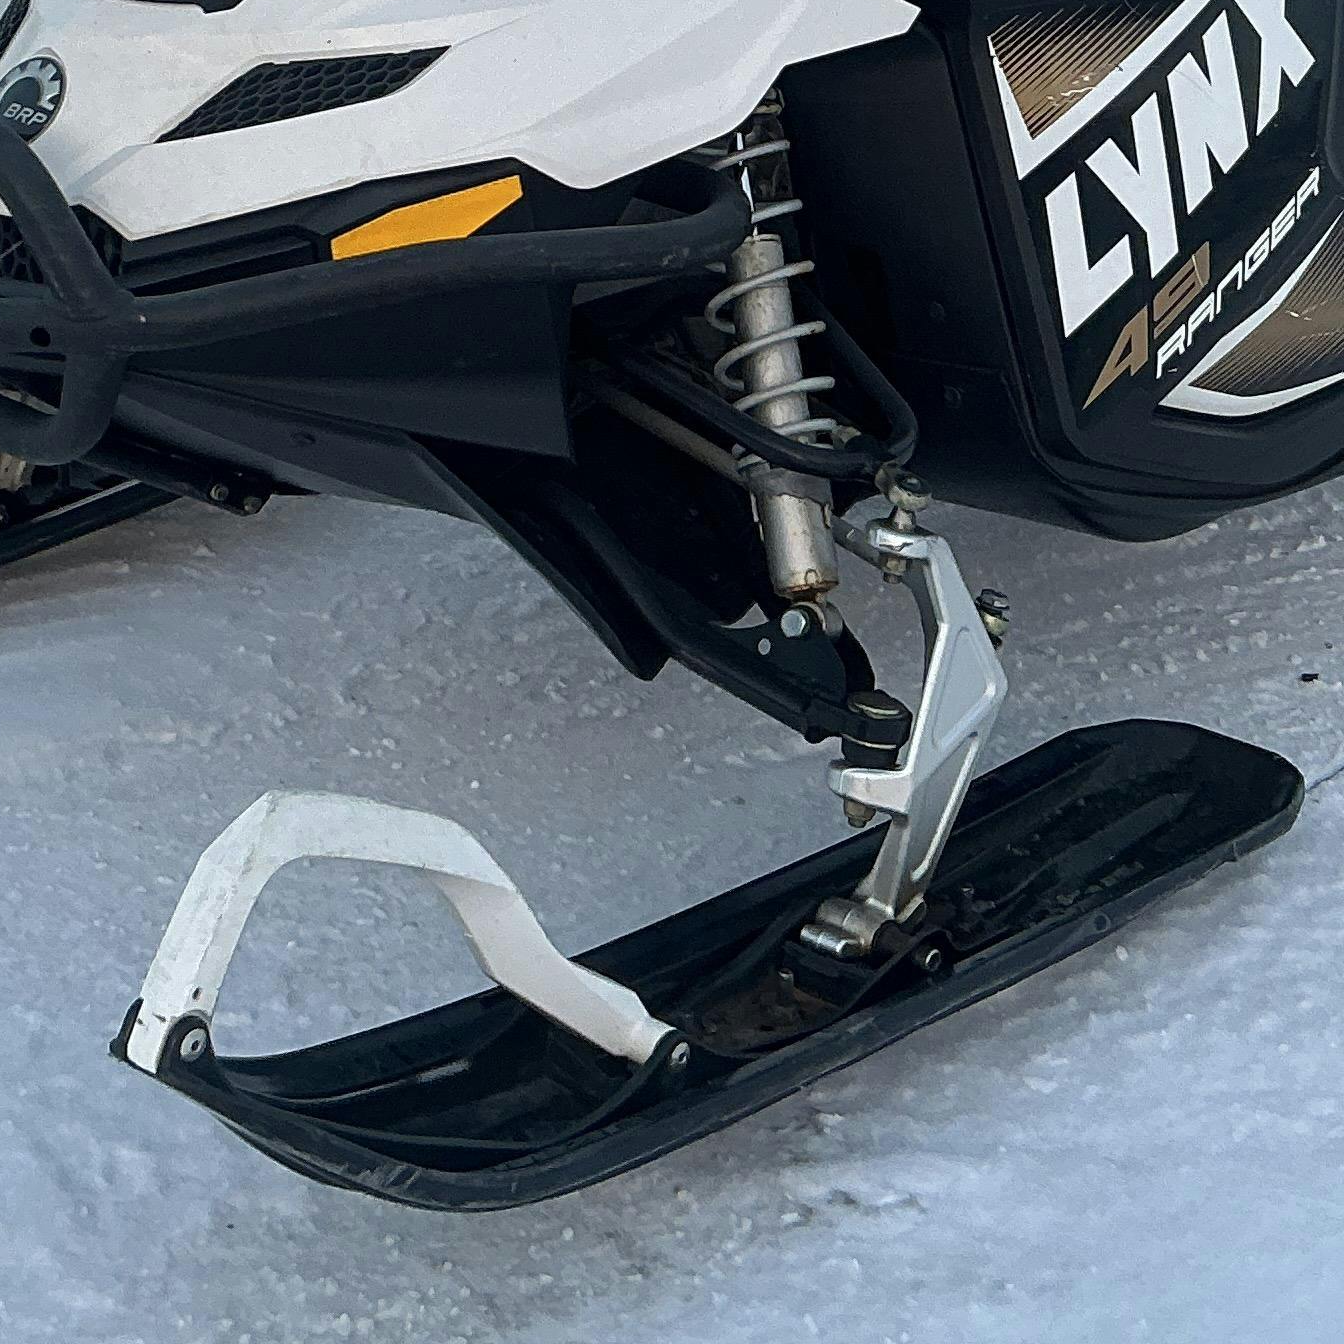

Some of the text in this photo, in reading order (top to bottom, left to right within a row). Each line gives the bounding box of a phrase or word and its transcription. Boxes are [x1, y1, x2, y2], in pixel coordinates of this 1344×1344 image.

[2, 102, 48, 126] BRP
[1081, 240, 1211, 412] 49
[1156, 165, 1321, 379] RANGER
